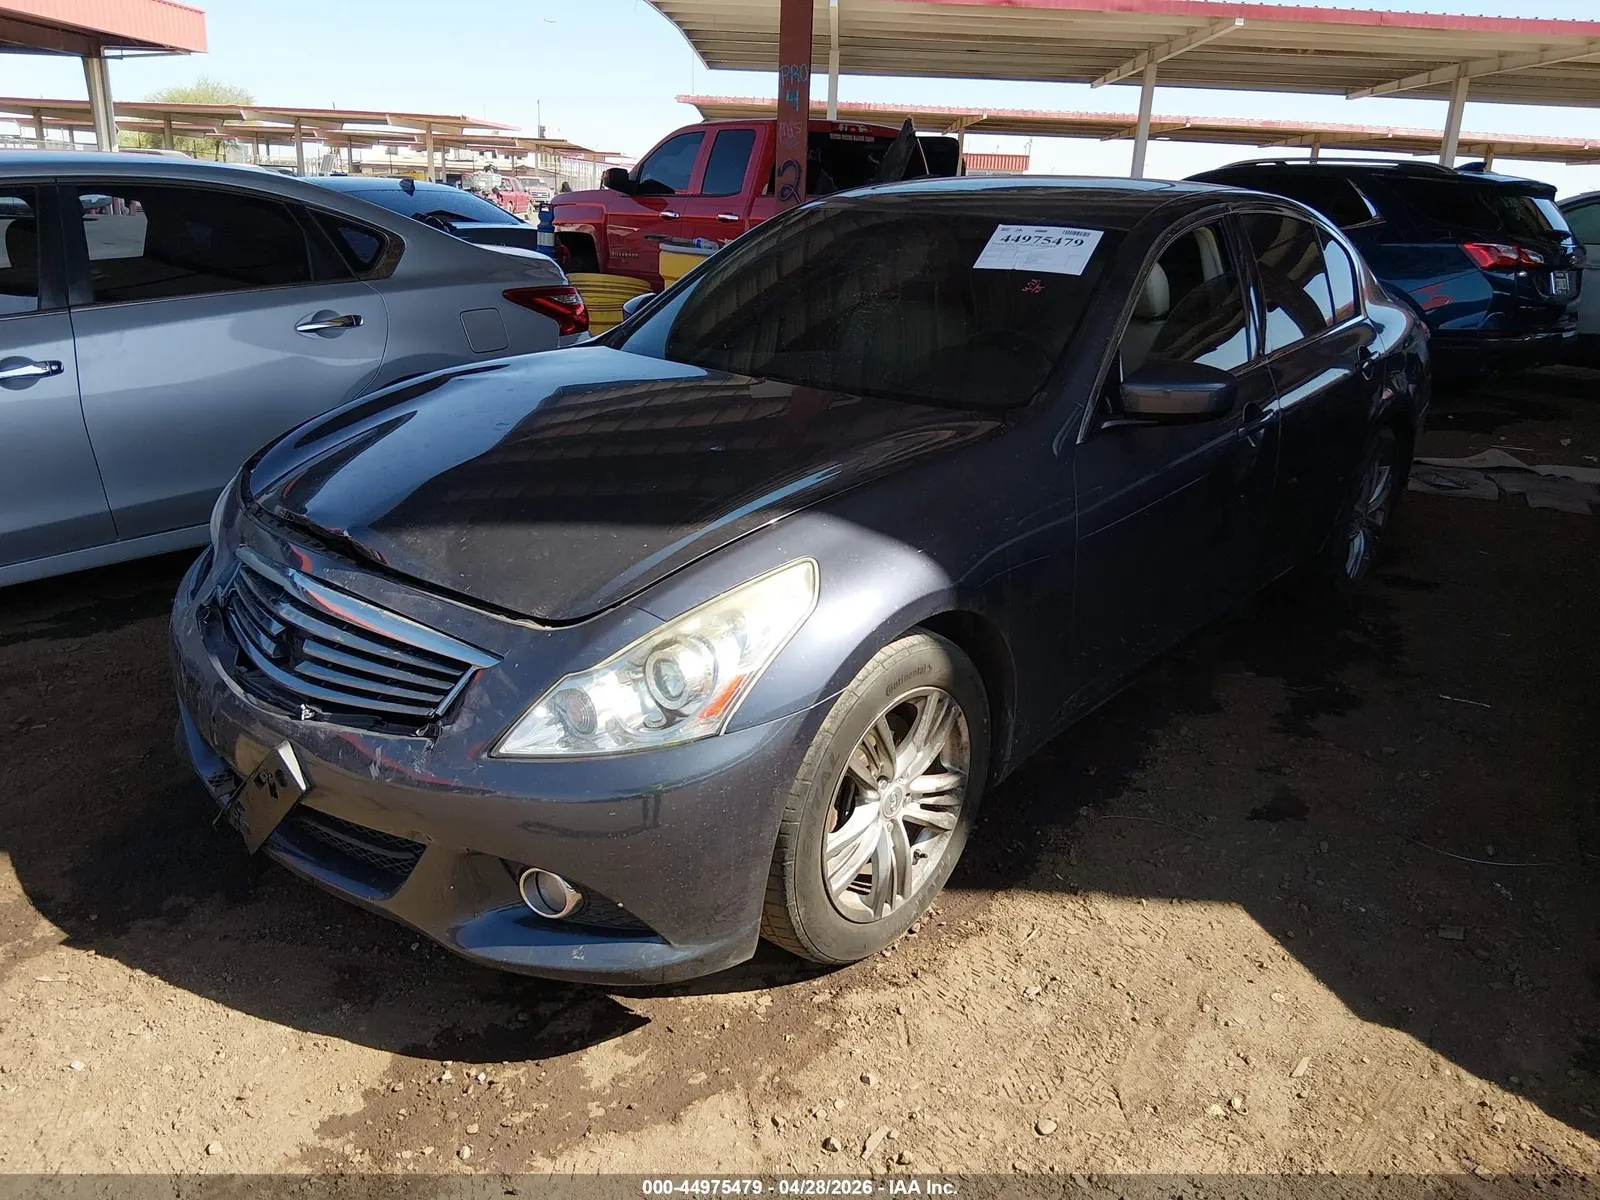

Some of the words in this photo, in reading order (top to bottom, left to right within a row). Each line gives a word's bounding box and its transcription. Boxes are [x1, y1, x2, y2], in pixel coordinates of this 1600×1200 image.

[779, 64, 809, 87] PRO
[785, 88, 800, 112] 4
[777, 159, 802, 204] 2
[1000, 234, 1084, 247] 44975479
